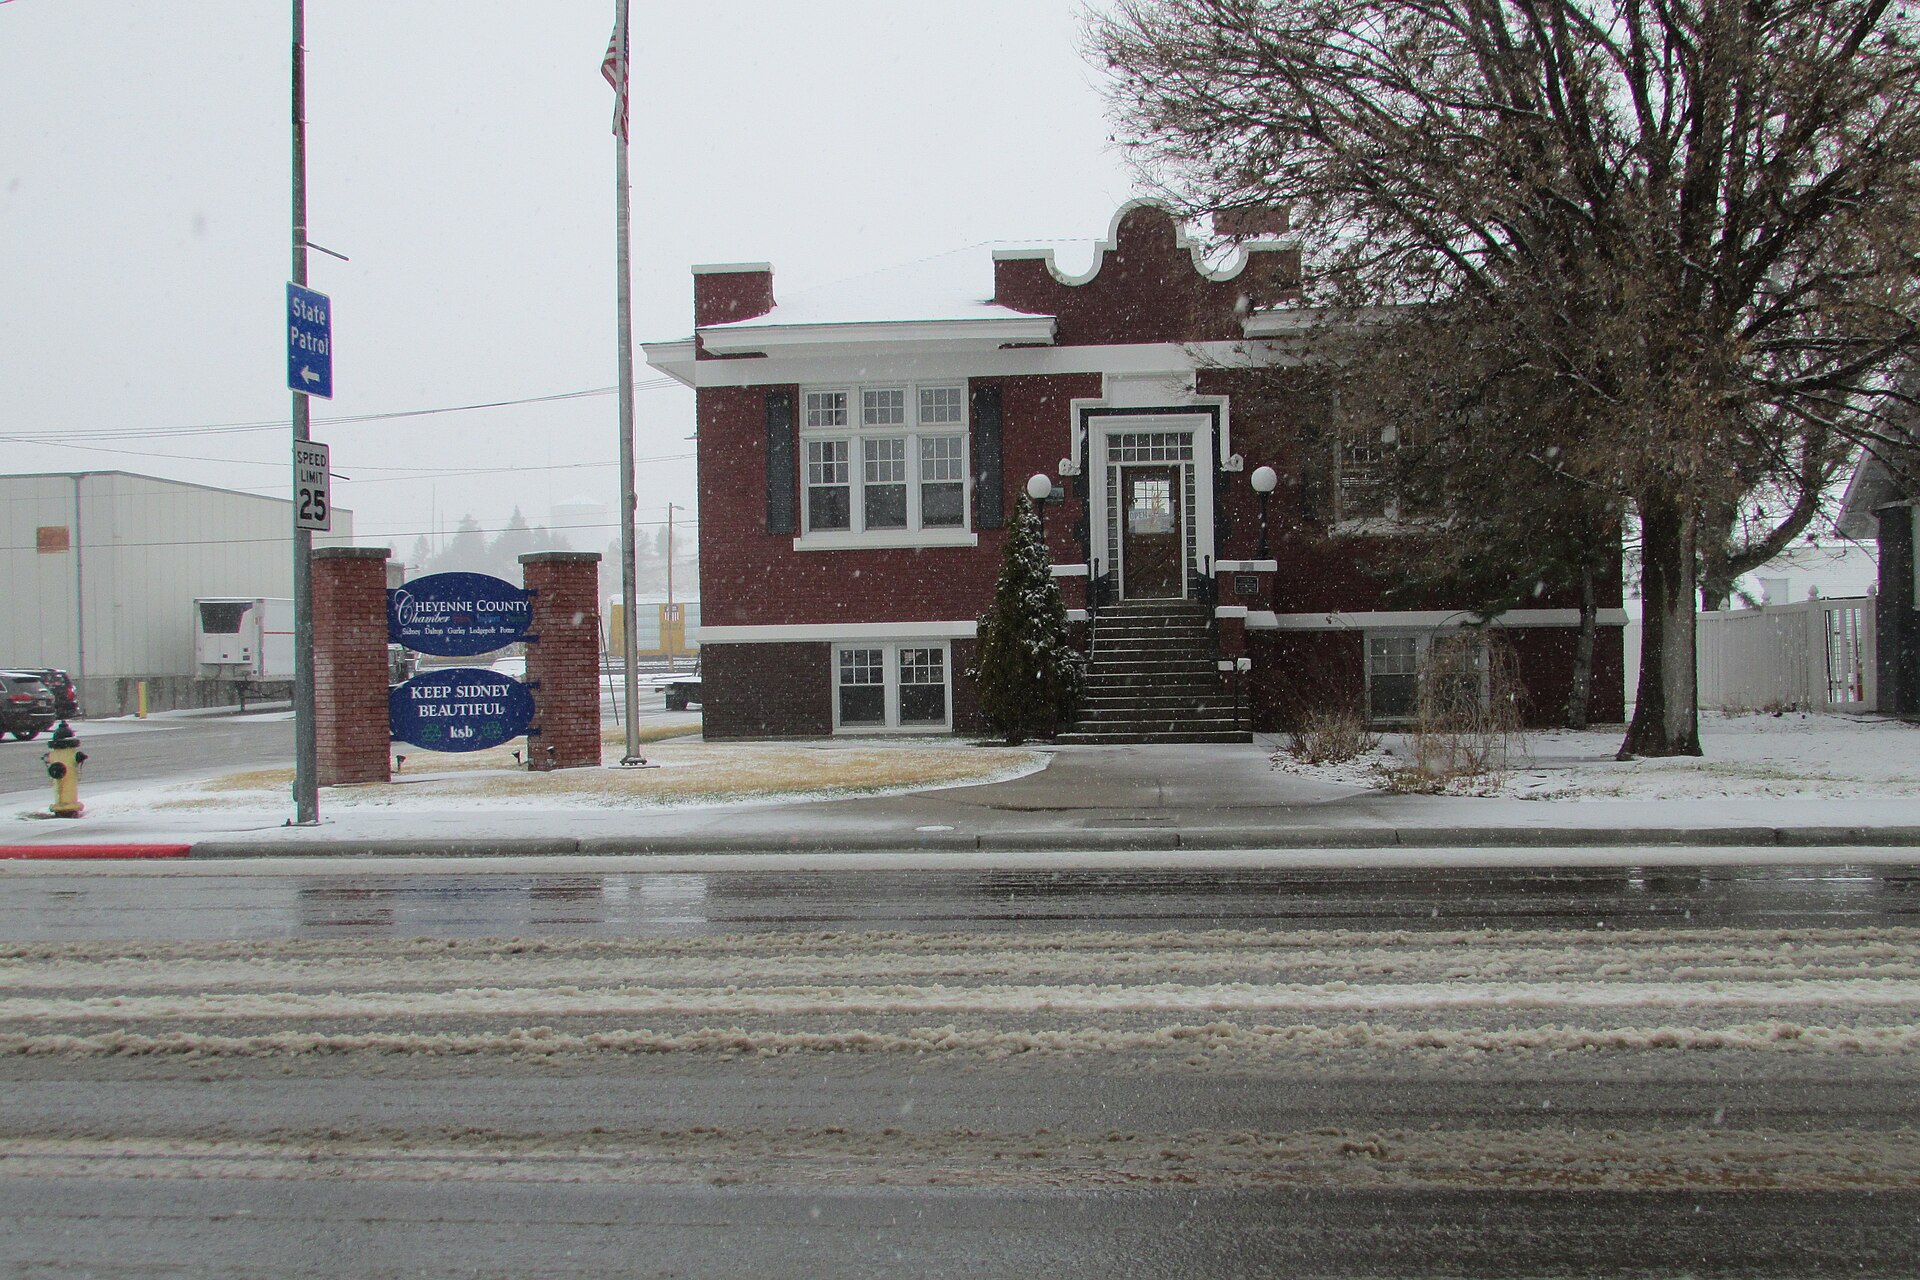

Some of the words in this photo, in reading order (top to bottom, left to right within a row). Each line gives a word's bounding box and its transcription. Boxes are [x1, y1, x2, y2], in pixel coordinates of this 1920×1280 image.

[293, 297, 326, 326] State
[291, 326, 329, 356] Patrol
[297, 451, 327, 467] SPEED
[301, 469, 324, 485] LIMIT
[299, 488, 327, 521] 25
[476, 599, 530, 612] COUNTY
[411, 686, 452, 699] KEEP
[456, 684, 510, 698] SIDNEY
[418, 703, 505, 717] BEAUTIFUL
[450, 725, 474, 739] ksb
